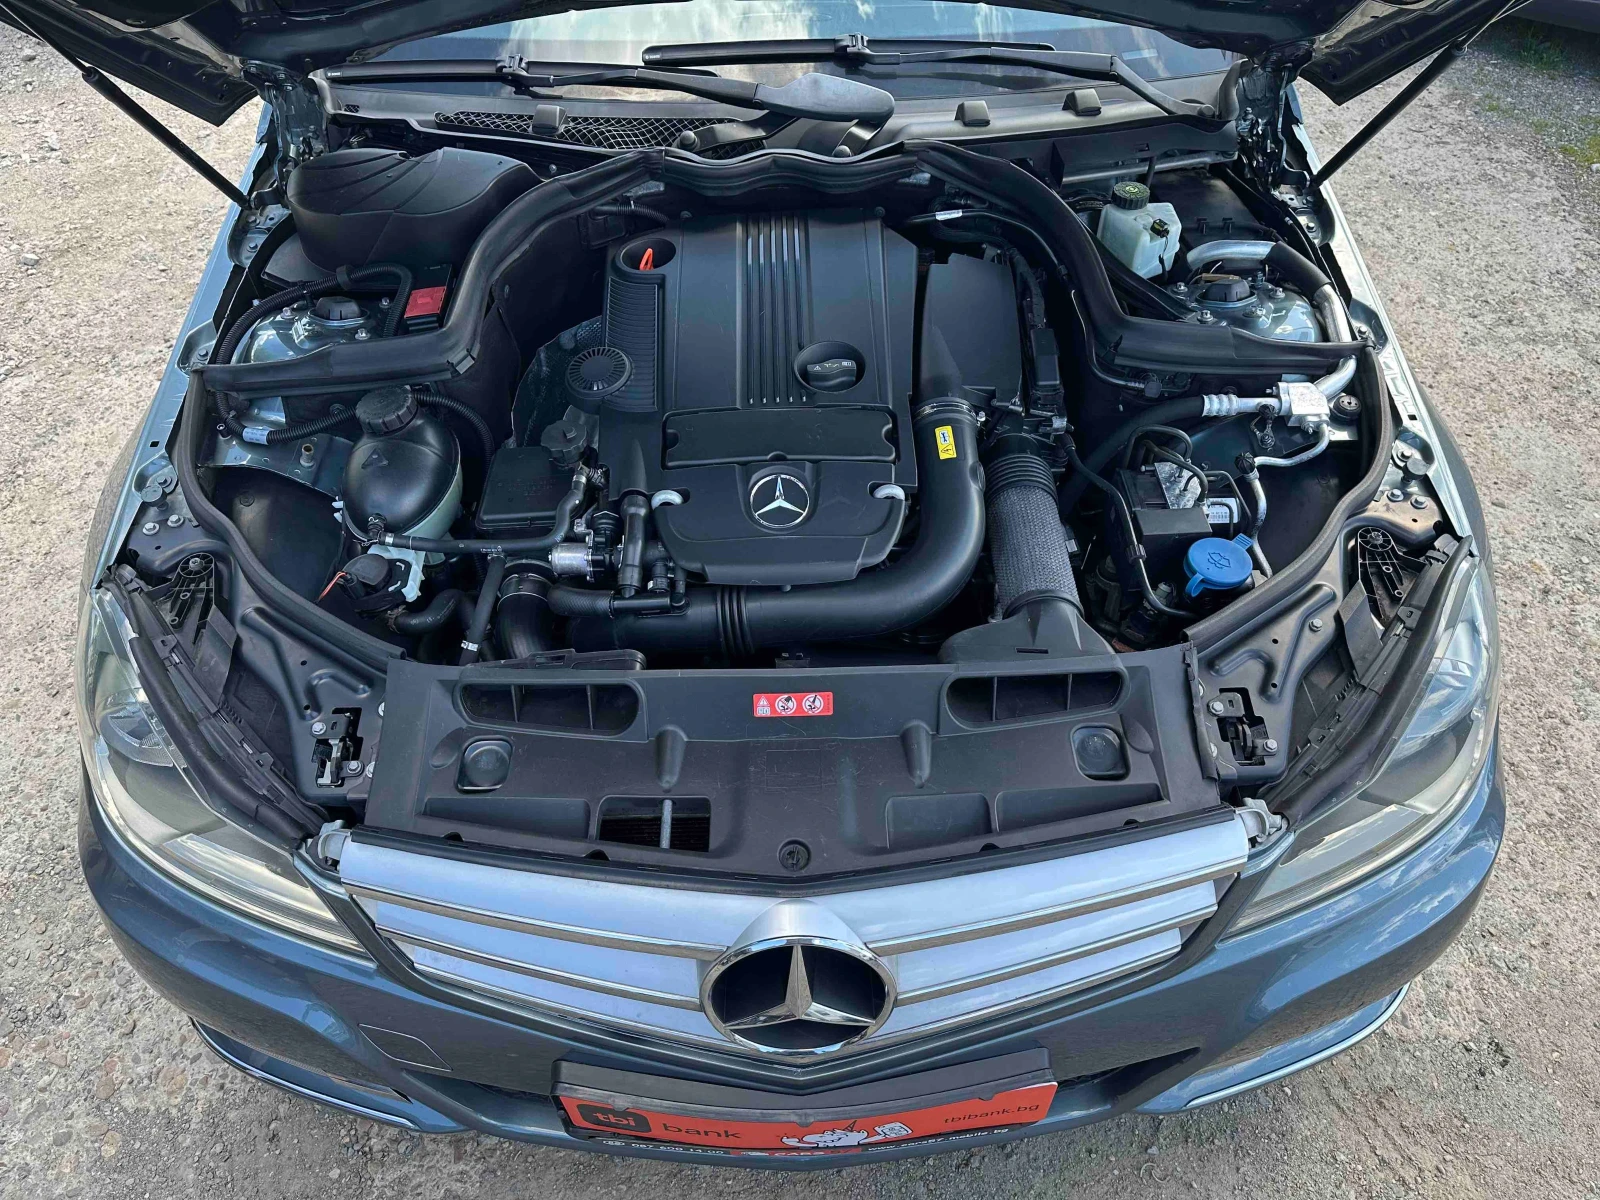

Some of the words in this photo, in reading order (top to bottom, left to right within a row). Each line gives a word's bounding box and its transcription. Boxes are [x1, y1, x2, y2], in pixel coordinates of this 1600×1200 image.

[593, 1112, 636, 1127] tbi
[662, 1123, 743, 1140] bank
[944, 1104, 1040, 1124] tbibank.bg
